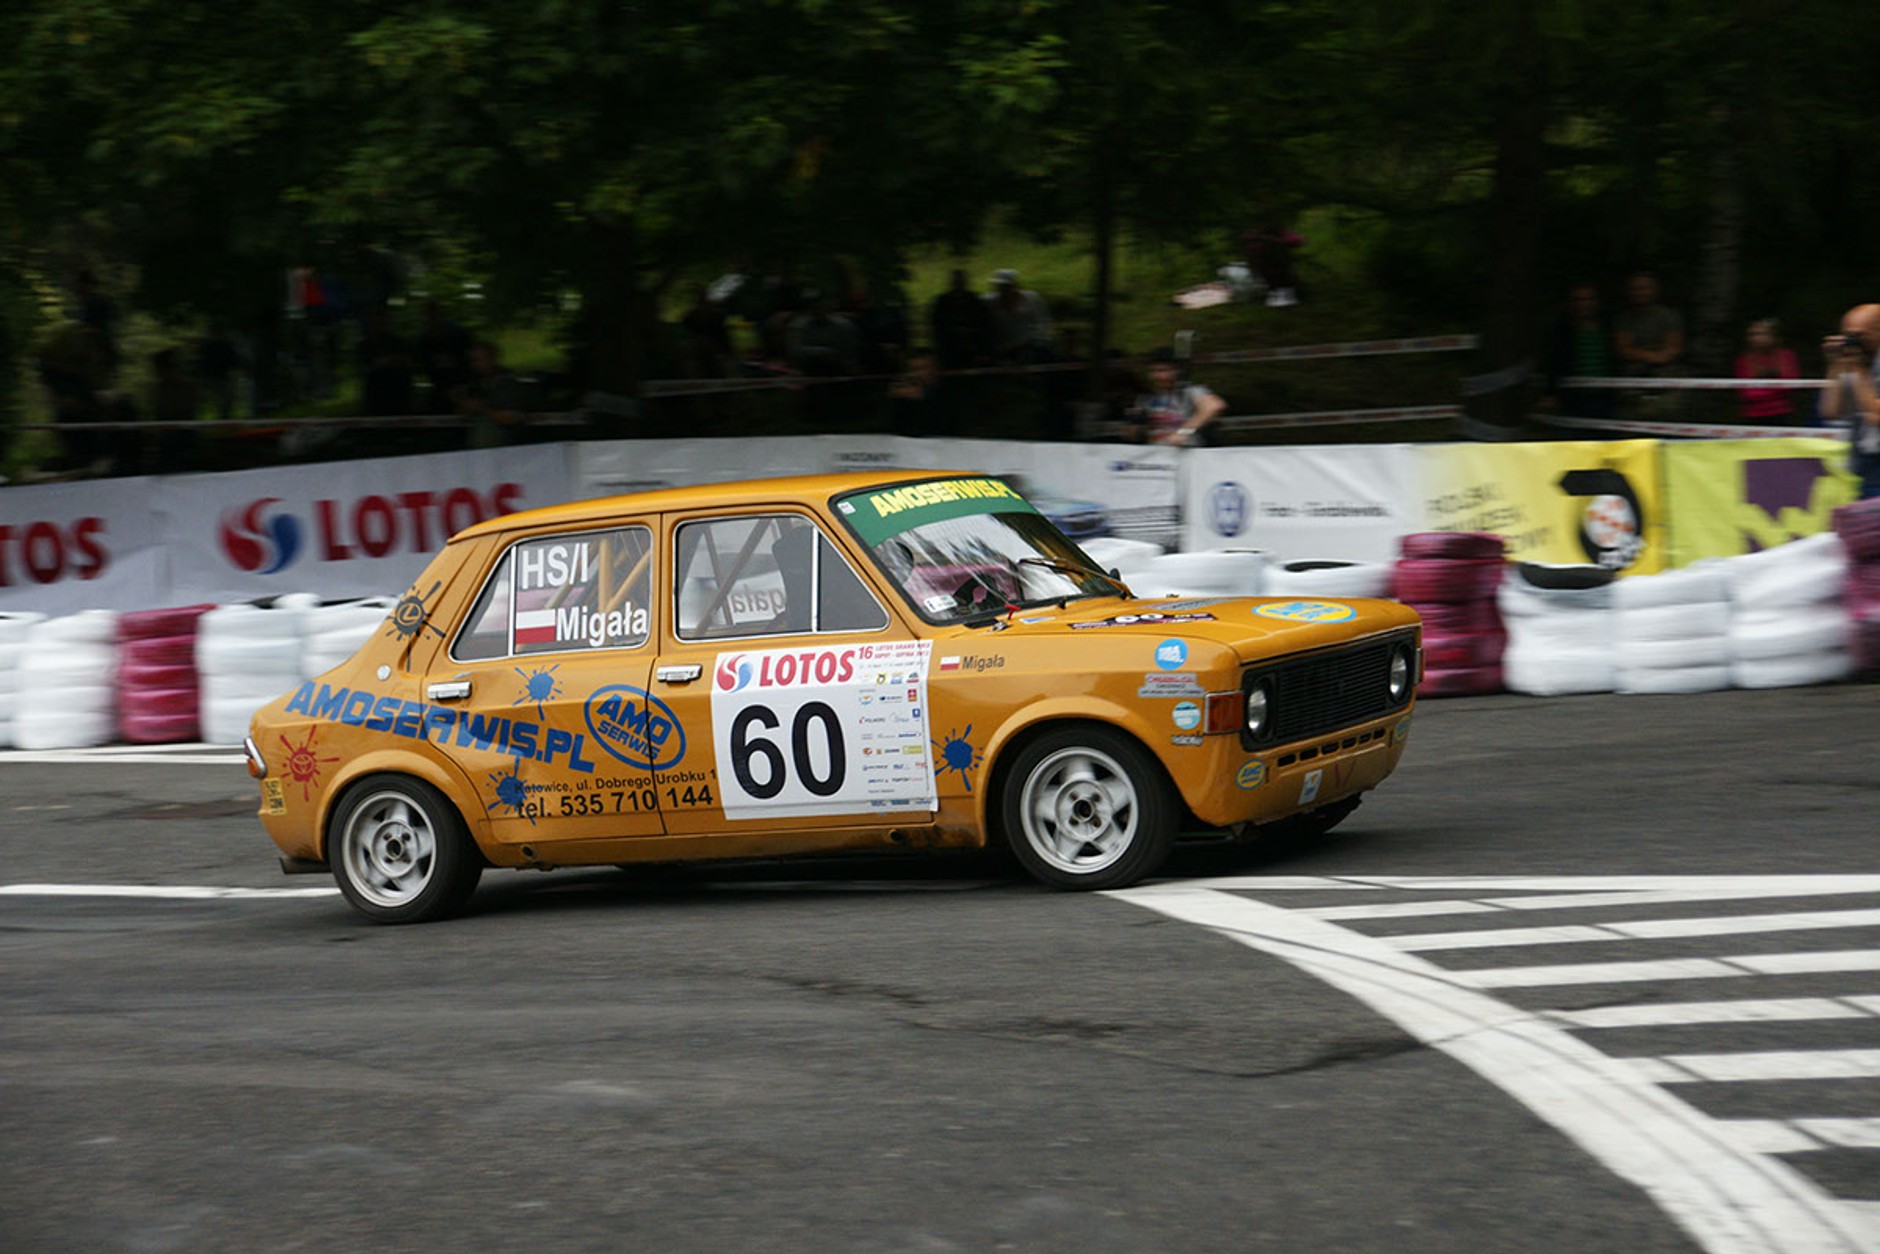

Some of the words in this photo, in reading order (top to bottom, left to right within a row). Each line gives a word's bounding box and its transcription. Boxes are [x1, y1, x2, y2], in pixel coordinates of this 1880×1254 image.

[522, 542, 589, 589] HS/I
[556, 602, 648, 646] Migała
[759, 650, 855, 687] LOTOS
[859, 646, 873, 659] 16
[962, 654, 1005, 672] Migała
[285, 682, 595, 773] AMOSERWIS.PL
[596, 694, 672, 746] AMO
[597, 720, 660, 760] SERWIS
[730, 701, 847, 800] 60
[576, 780, 592, 791] ul.
[596, 777, 651, 790] Dobrego
[656, 771, 706, 785] Urobku
[518, 797, 552, 818] tel.
[561, 794, 604, 817] 535
[611, 790, 656, 813] 710
[666, 785, 713, 808] 144
